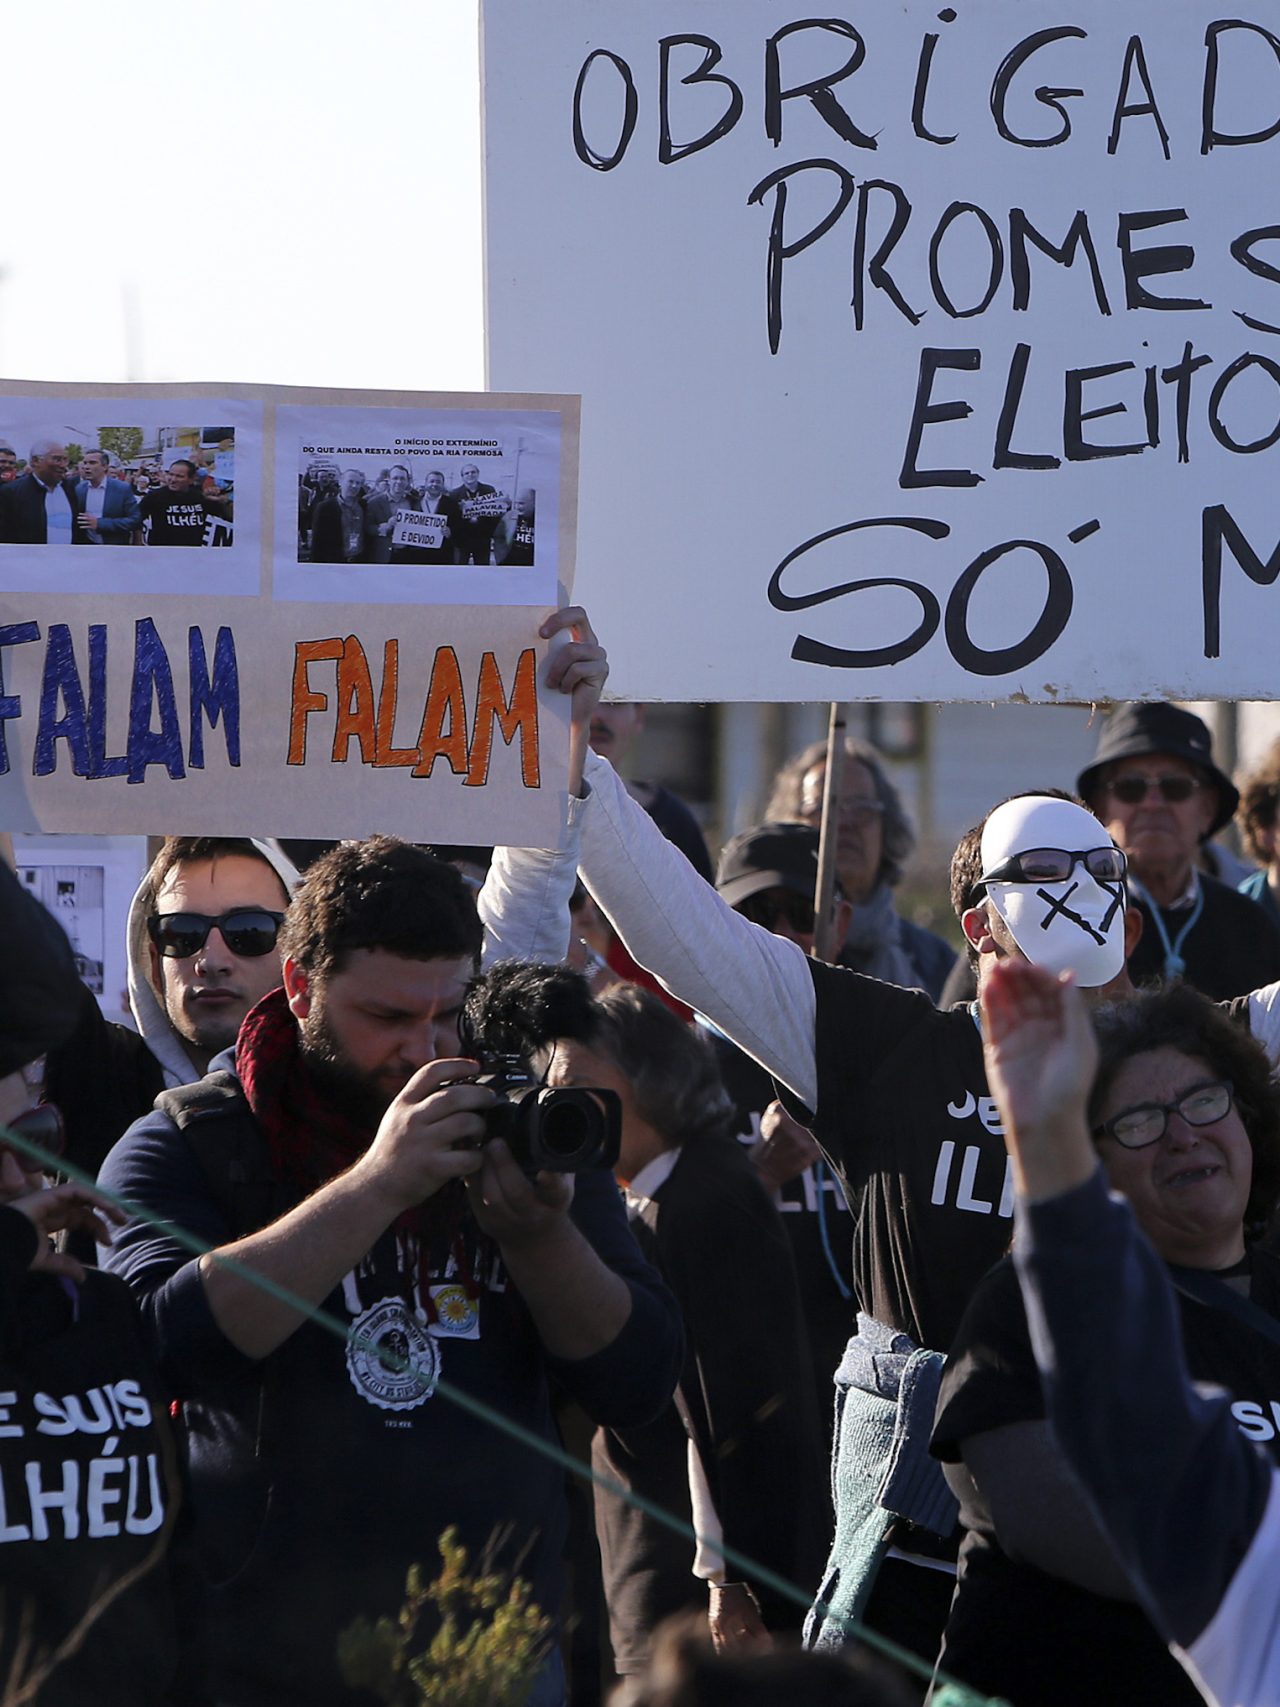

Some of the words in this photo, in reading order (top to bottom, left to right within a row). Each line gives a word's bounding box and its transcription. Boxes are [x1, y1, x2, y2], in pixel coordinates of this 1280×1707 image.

[403, 512, 446, 528] PROMETIDO
[408, 532, 435, 545] DEVIDO
[767, 516, 1101, 676] SÓ
[0, 616, 241, 784] FALAM
[287, 634, 541, 788] FALAM
[0, 1391, 24, 1438] E
[33, 1379, 152, 1436] SUIS
[0, 1436, 165, 1543] LHÉU
